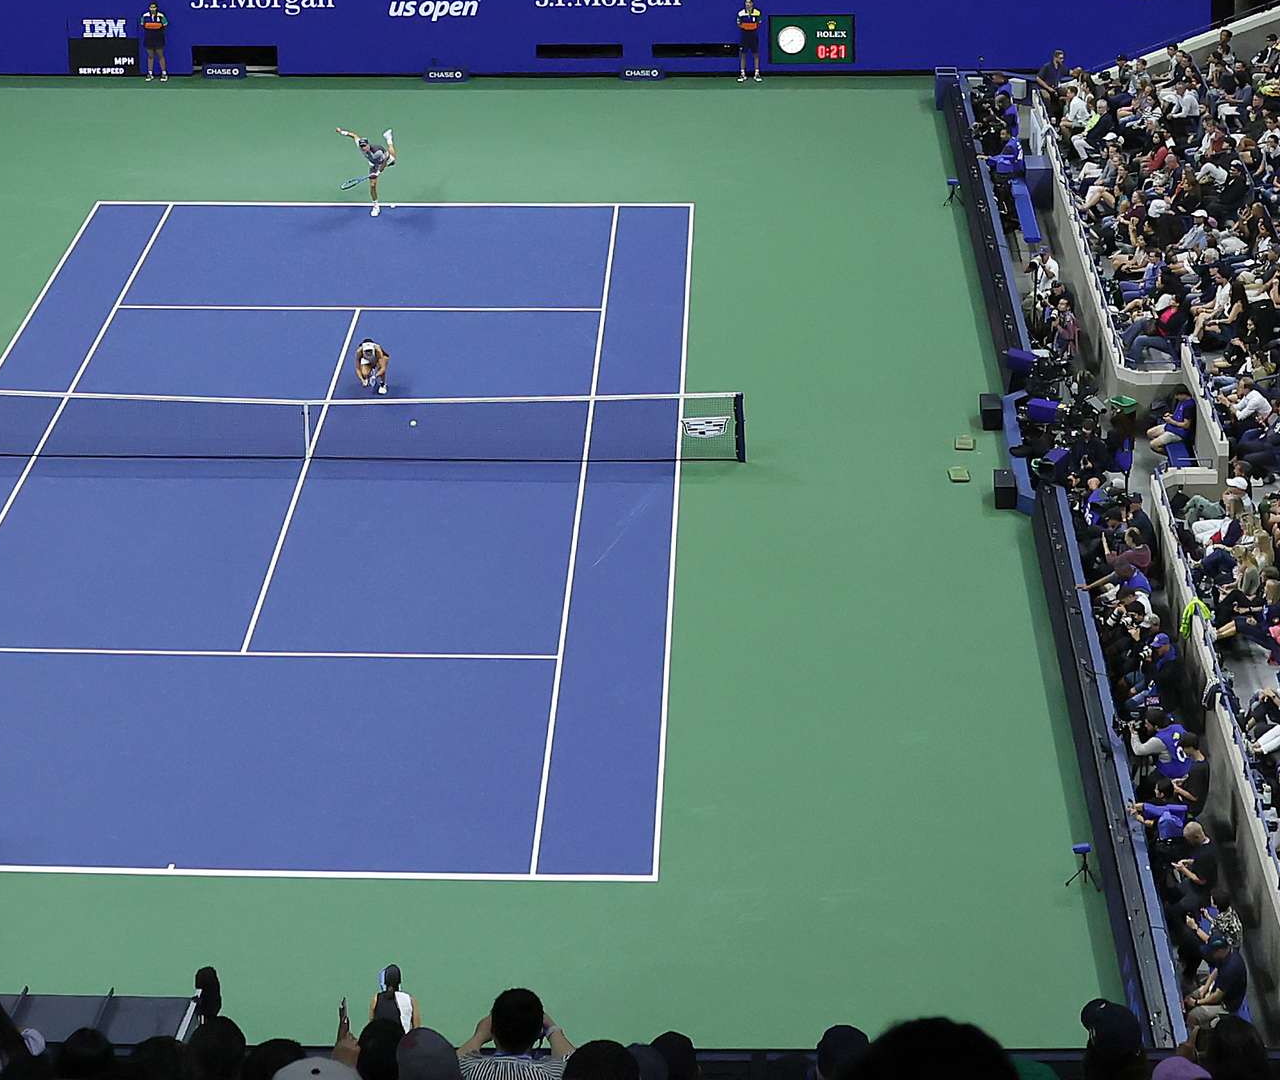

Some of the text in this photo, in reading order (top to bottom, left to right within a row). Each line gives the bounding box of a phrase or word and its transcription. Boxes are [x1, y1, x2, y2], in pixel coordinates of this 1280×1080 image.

[389, 0, 478, 22] us open
[82, 19, 127, 38] IBM
[816, 30, 848, 39] ROLEX
[816, 44, 848, 59] 0:21
[114, 56, 135, 66] MPH
[78, 67, 125, 75] SERVE SPEED
[428, 71, 455, 79] CHASE
[625, 69, 651, 77] CHASE
